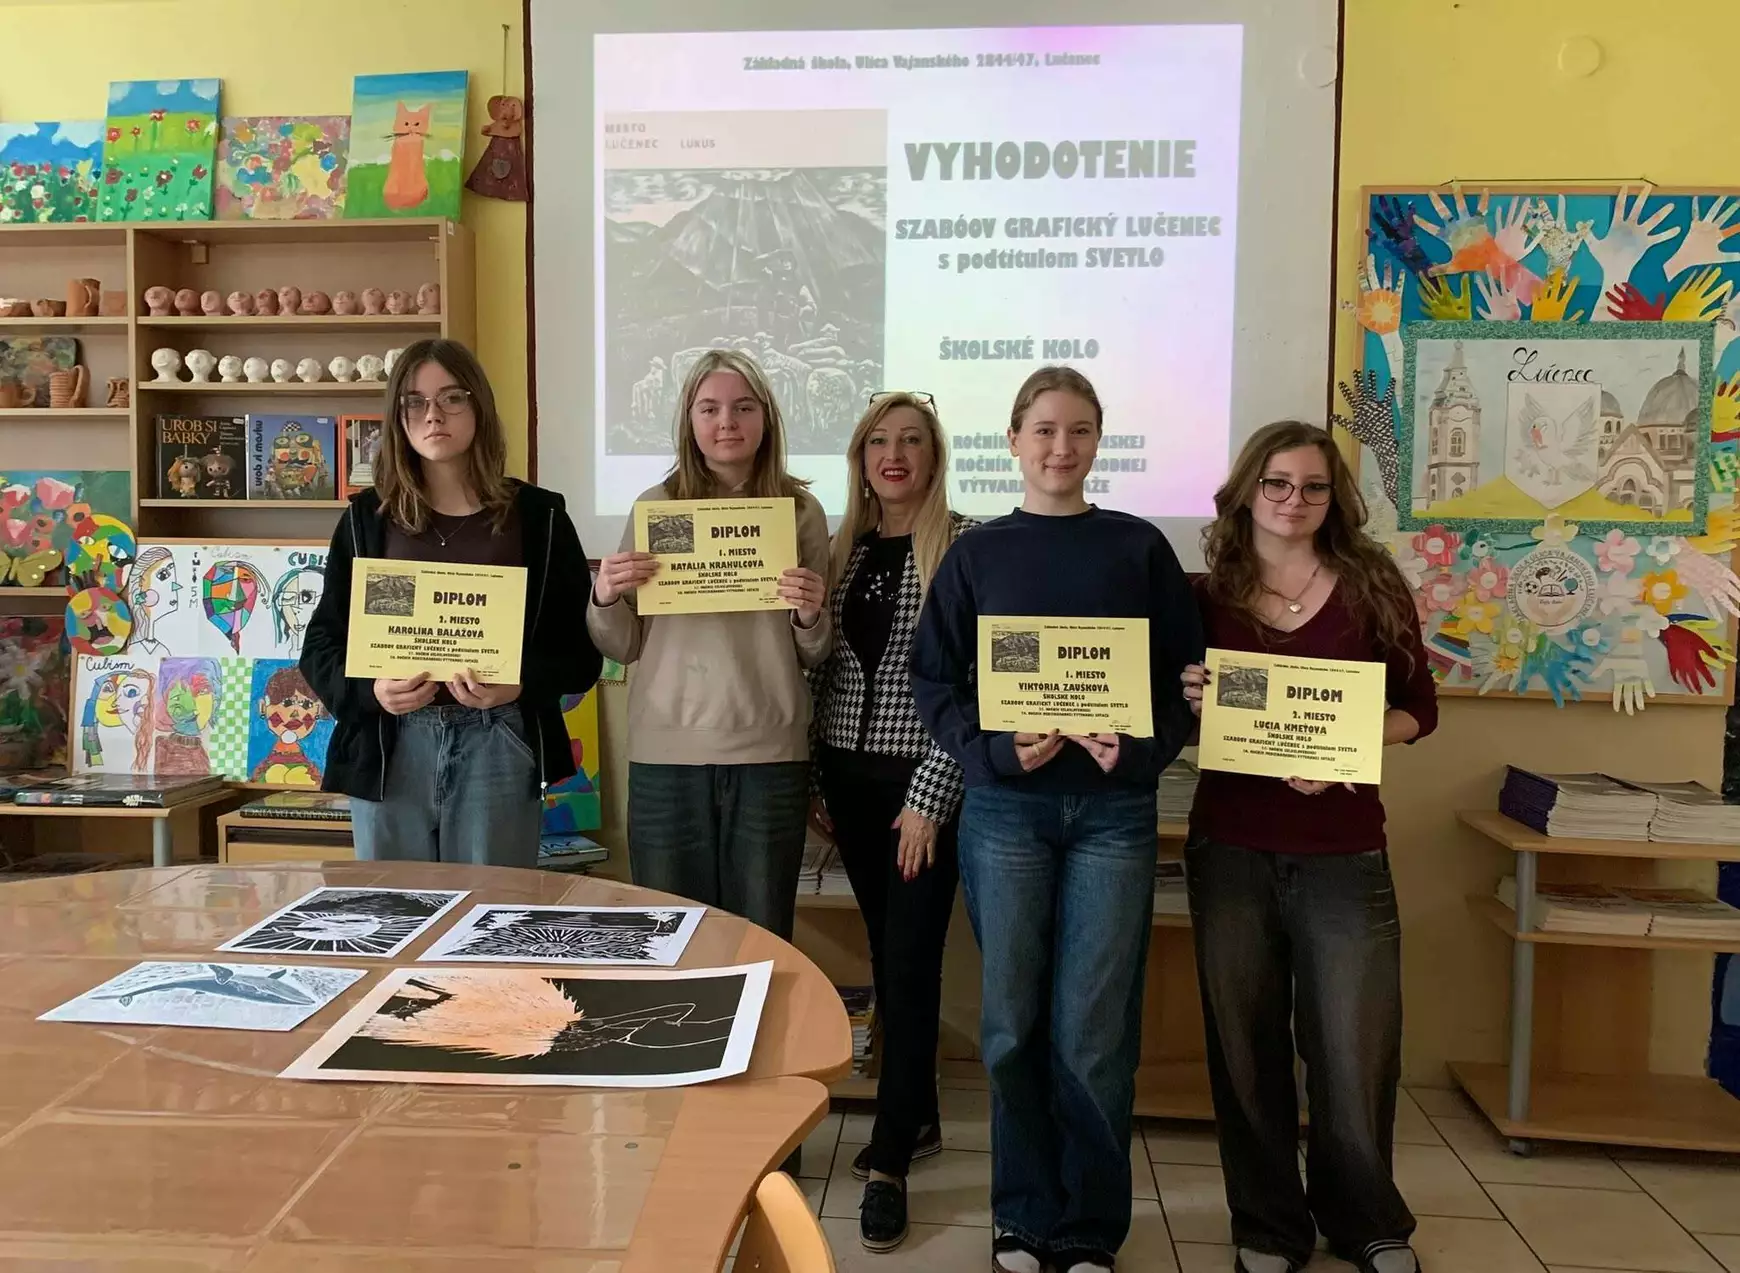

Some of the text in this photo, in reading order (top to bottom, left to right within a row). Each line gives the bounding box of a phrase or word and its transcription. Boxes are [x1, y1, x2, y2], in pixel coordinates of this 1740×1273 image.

[904, 140, 1197, 181] VYHODOTENIE
[895, 212, 1222, 240] SZABÓOV GRAFICKÝ LUČENEC
[938, 247, 1165, 274] s podtitulom SVETLO
[939, 336, 1100, 360] ŠKOLSKÉ KOLO
[161, 419, 218, 432] UROB SI
[252, 420, 263, 452] masku
[252, 464, 263, 487] urob
[711, 525, 760, 539] DIPLOM
[728, 547, 757, 556] MIESTO
[433, 591, 487, 607] DIPLOM
[439, 615, 480, 625] 2. MIESTO
[1058, 646, 1111, 660] DIPLOM
[86, 656, 135, 671] Cubism
[1076, 670, 1106, 679] MIESTO
[1286, 685, 1343, 703] DIPLOM
[1293, 710, 1336, 722] 2. MIESTO
